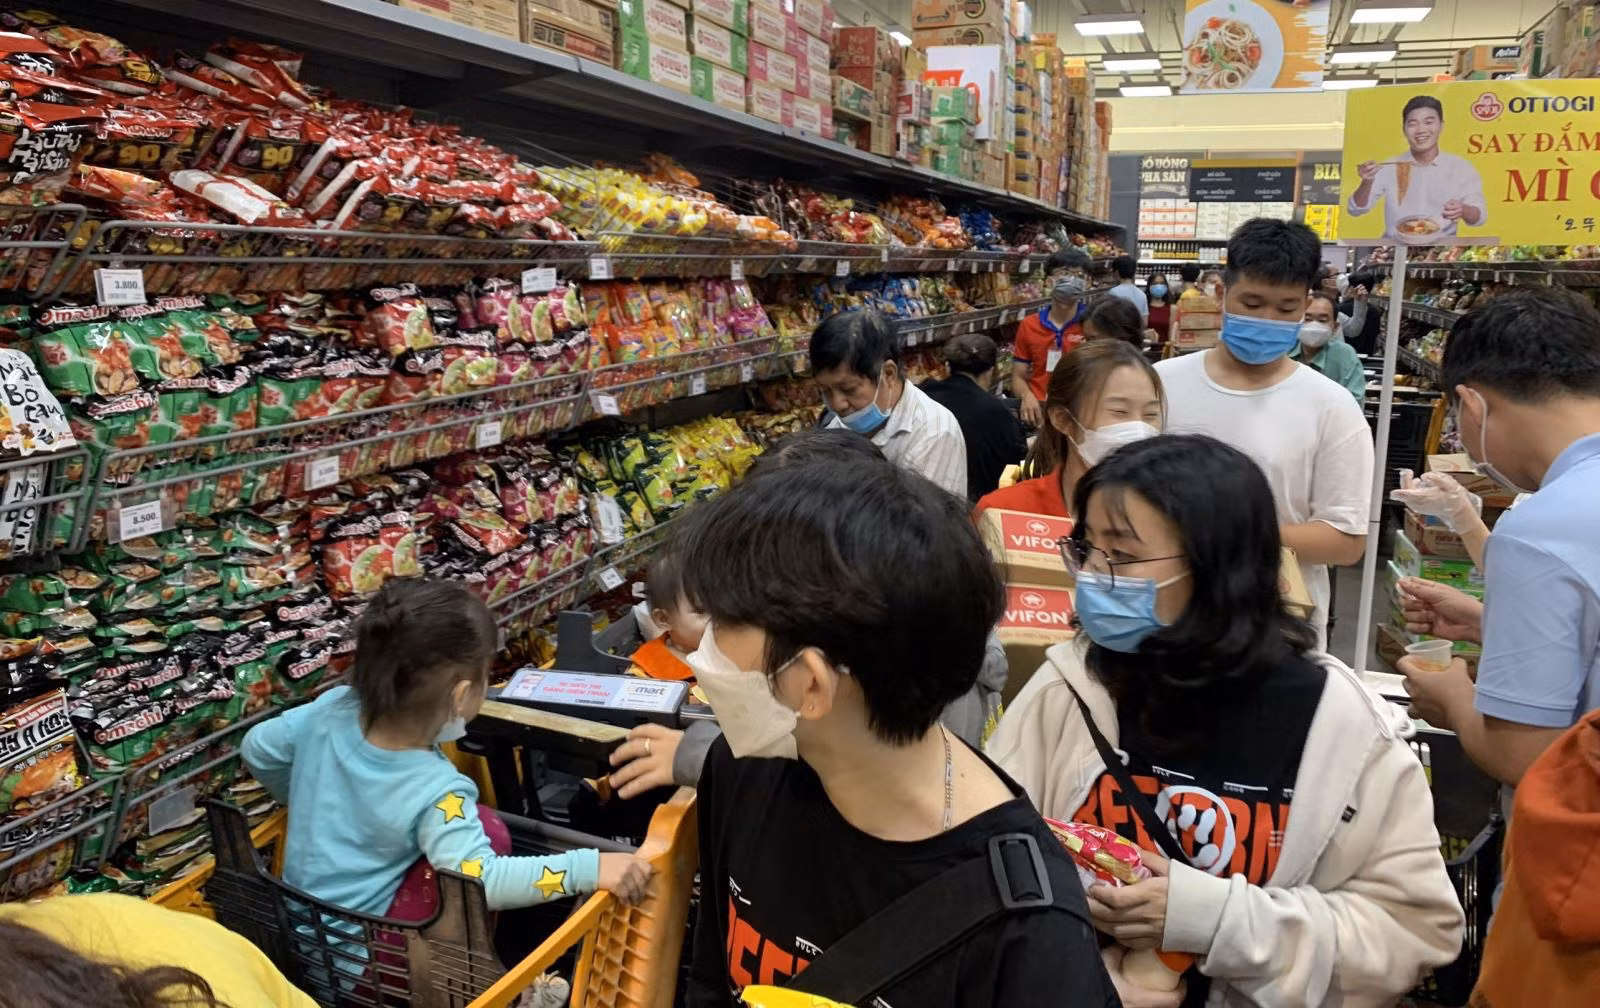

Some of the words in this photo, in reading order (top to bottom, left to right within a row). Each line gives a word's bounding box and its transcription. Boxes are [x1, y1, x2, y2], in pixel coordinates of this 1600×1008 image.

[1509, 96, 1595, 113] OTTOGI
[1467, 132, 1526, 154] SAY
[1534, 122, 1600, 152] ĐẮM
[119, 144, 160, 165] 90
[262, 145, 293, 167] 90
[1314, 163, 1340, 181] BIA
[1502, 157, 1574, 203] MÌ
[1010, 534, 1060, 549] VIFO
[1005, 609, 1069, 625] VIFON
